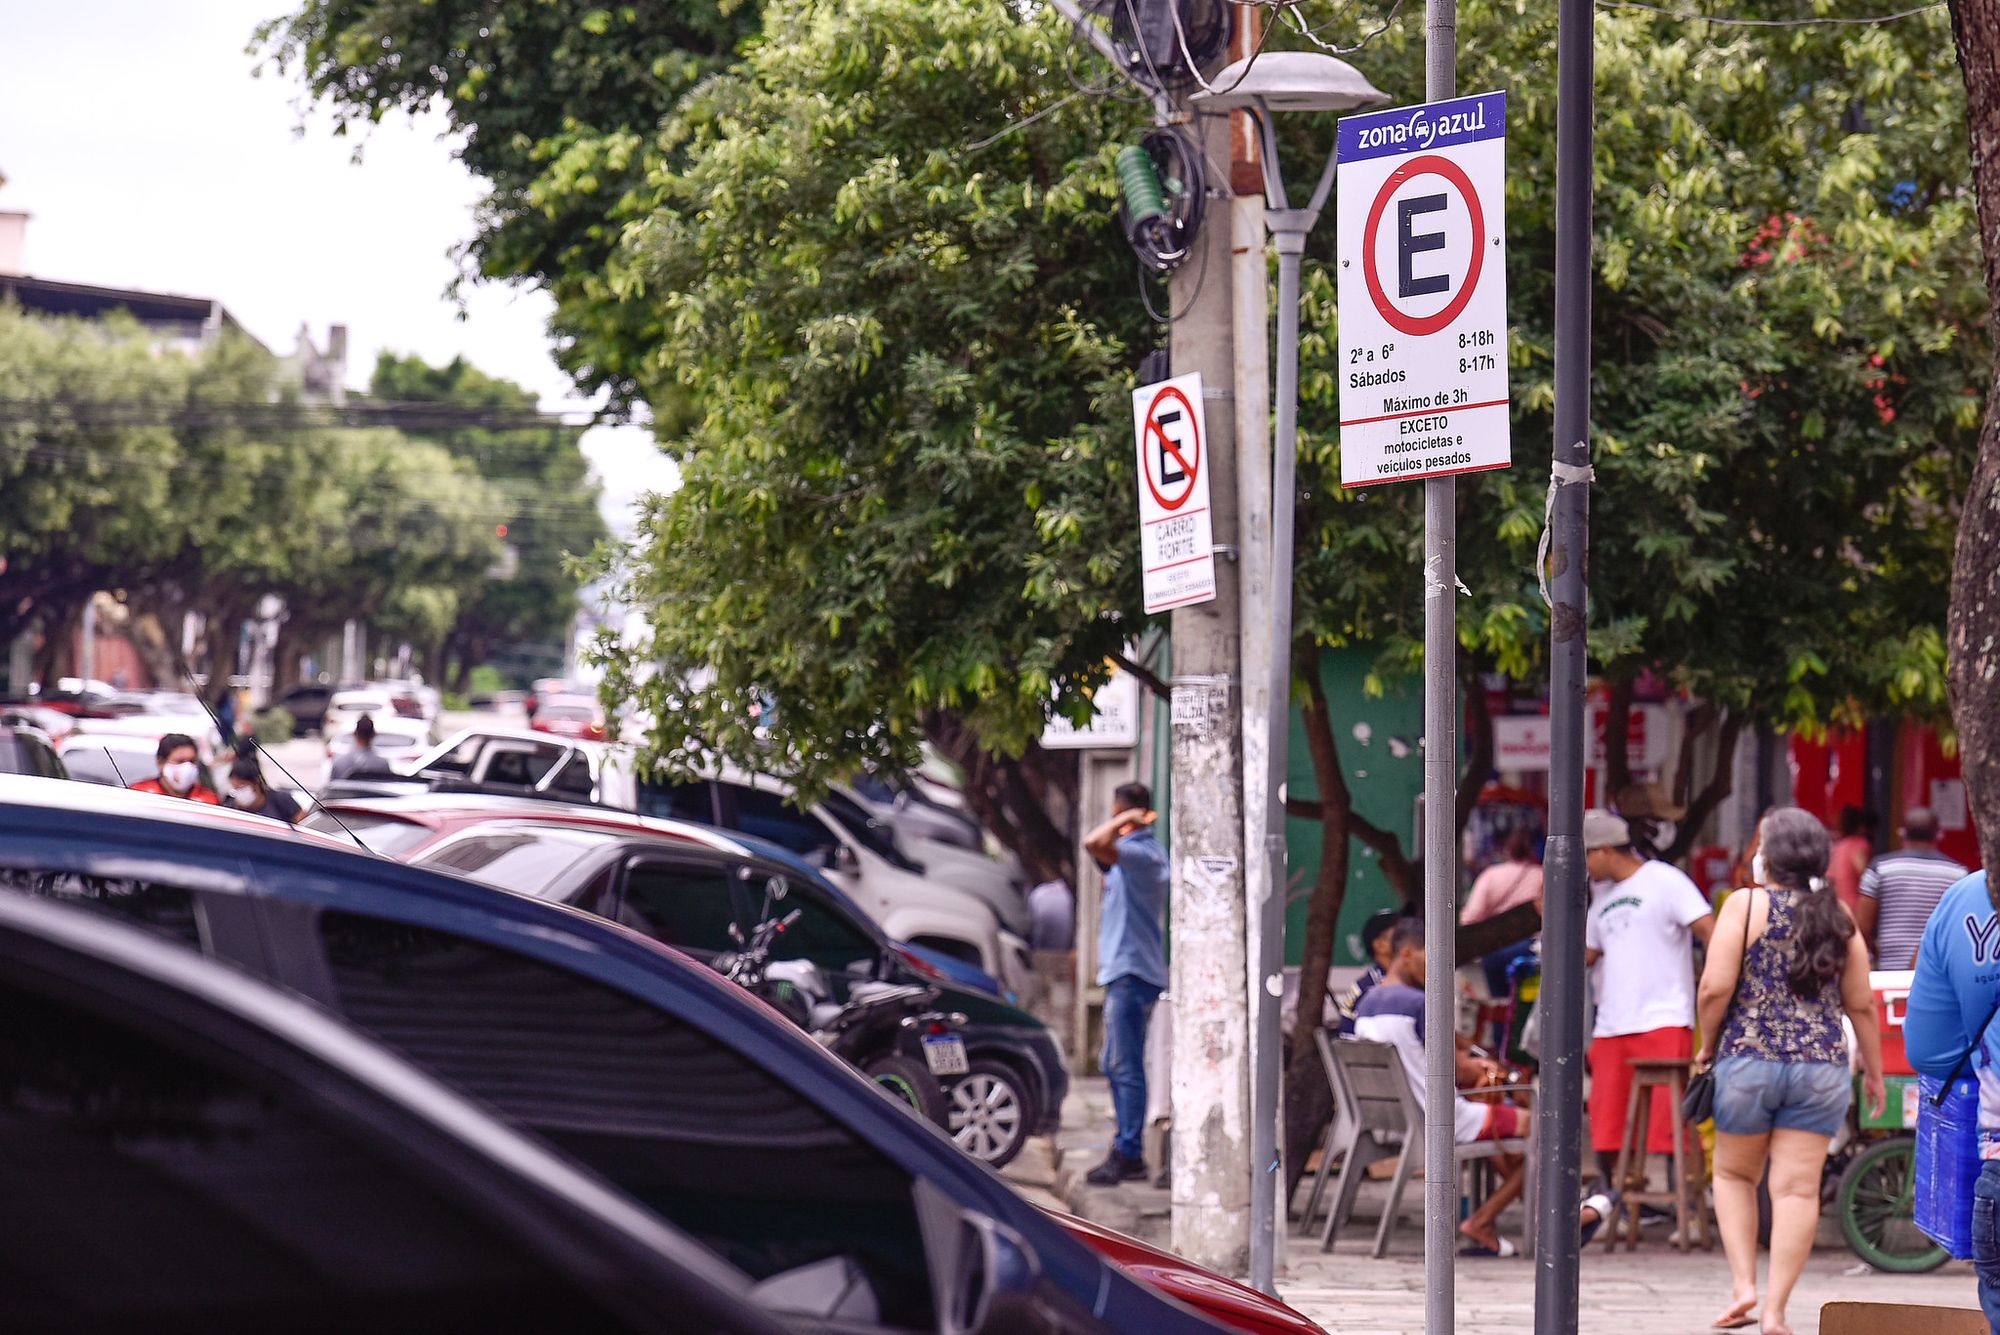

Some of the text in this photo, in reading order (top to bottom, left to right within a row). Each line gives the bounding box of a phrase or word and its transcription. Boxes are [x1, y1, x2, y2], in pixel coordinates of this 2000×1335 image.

[1358, 102, 1486, 149] zona azul
[1398, 193, 1449, 298] E
[1458, 330, 1494, 349] 8-18h
[1366, 350, 1374, 363] a
[1459, 355, 1495, 374] 8-17h
[1350, 369, 1406, 389] Sábados
[1383, 388, 1468, 413] Máximo de 3h
[1399, 415, 1448, 435] EXCETO
[1158, 411, 1185, 485] E
[1384, 434, 1463, 455] motocicletas e
[1376, 451, 1471, 474] veículos pesados
[1155, 516, 1197, 541] CARRO
[1157, 536, 1196, 562] FORTE
